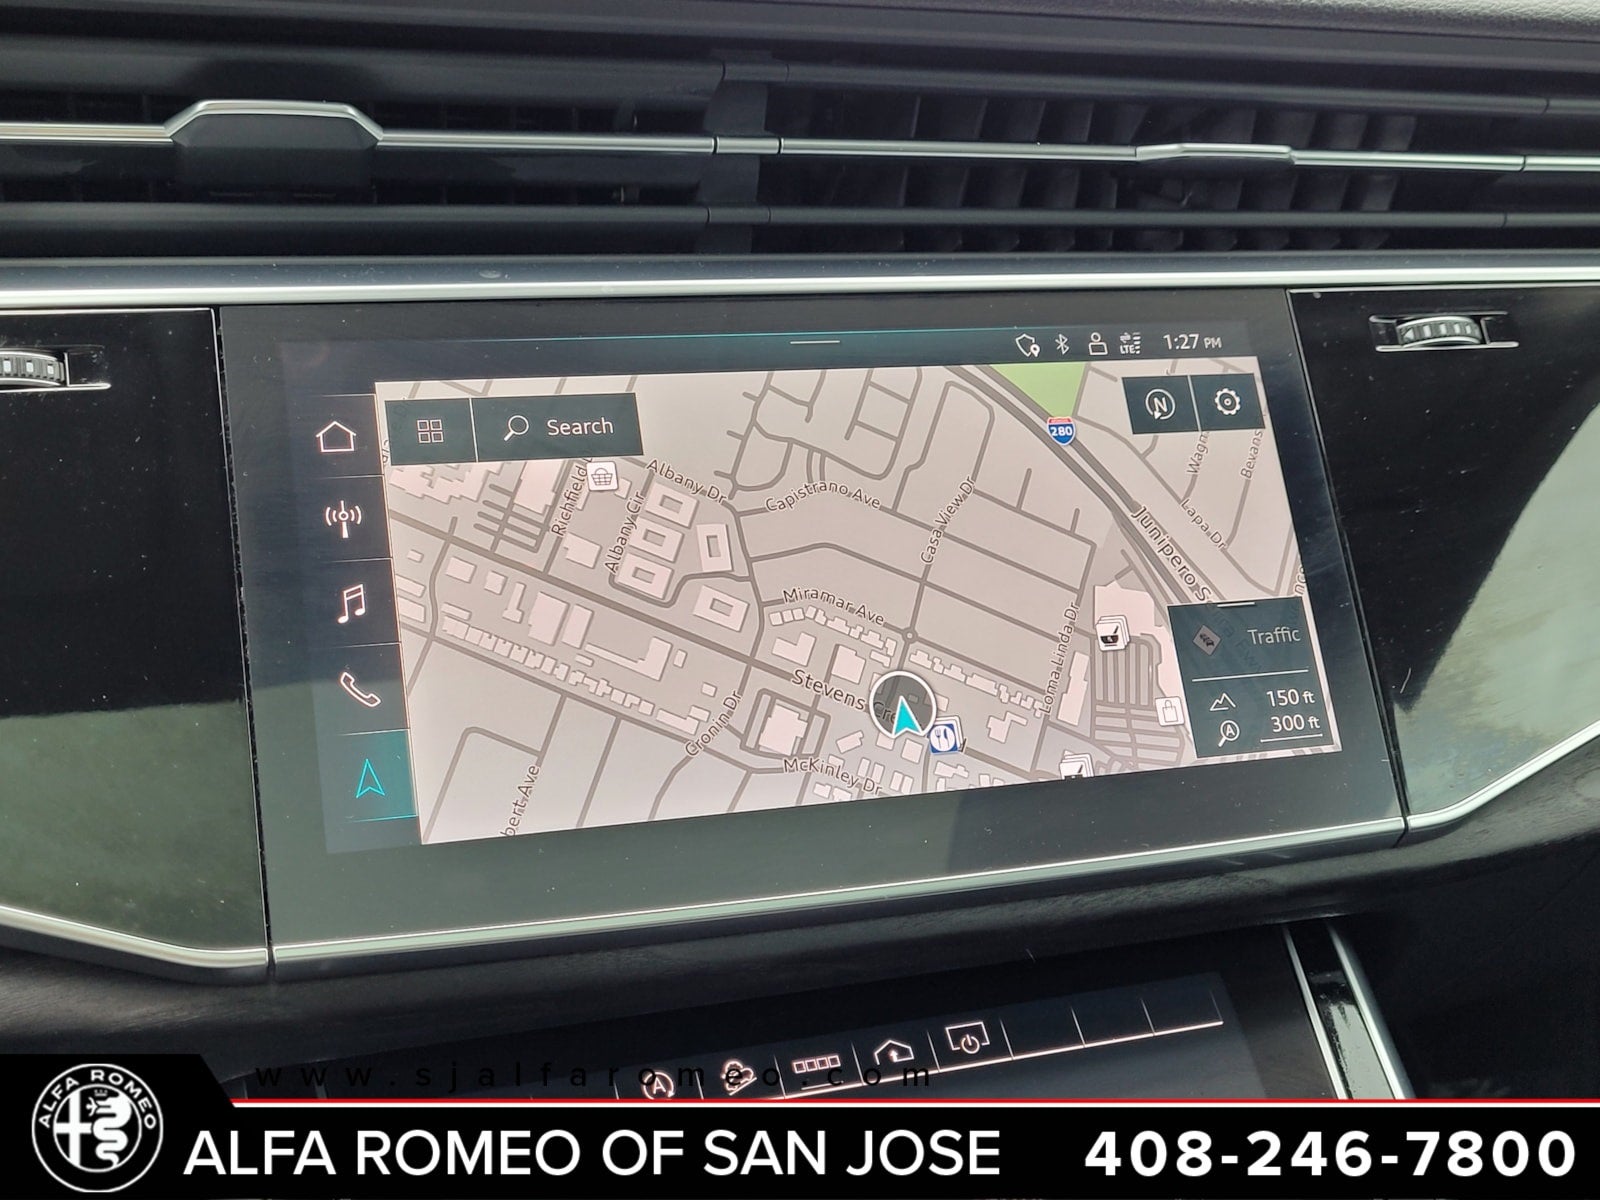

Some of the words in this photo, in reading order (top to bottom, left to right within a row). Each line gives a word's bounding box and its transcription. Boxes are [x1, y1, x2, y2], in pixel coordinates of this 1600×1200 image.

[1119, 344, 1136, 354] LTE
[1163, 333, 1200, 350] 1:27
[1203, 337, 1222, 349] PM
[546, 416, 614, 436] Search
[1050, 426, 1073, 437] 280
[646, 458, 704, 495] Albany
[706, 485, 727, 504] Dr
[765, 480, 849, 512] Capistrano
[852, 488, 881, 509] Ave
[551, 464, 587, 537] Richfield
[604, 516, 638, 574] Albany
[627, 491, 645, 521] Cir
[920, 528, 943, 565] Casa
[934, 491, 965, 527] View
[959, 475, 976, 496] Dr
[1180, 498, 1210, 534] Lapa
[1208, 529, 1227, 550] Dr
[1131, 505, 1197, 587] Junipero
[782, 587, 853, 614] Miramar
[854, 605, 884, 626] Ave
[1247, 625, 1301, 647] Traffic
[1039, 667, 1061, 715] Loma
[1051, 623, 1074, 667] Linda
[1064, 601, 1080, 623] Dr
[791, 669, 867, 711] Stevens
[1265, 688, 1300, 708] 150
[1302, 690, 1316, 705] ft
[685, 710, 731, 758] Cronin
[723, 690, 743, 712] Dr
[1271, 714, 1305, 733] 300
[1307, 716, 1321, 730] ft
[516, 764, 541, 801] Ave
[783, 757, 859, 788] McKinley
[862, 777, 884, 795] Dr
